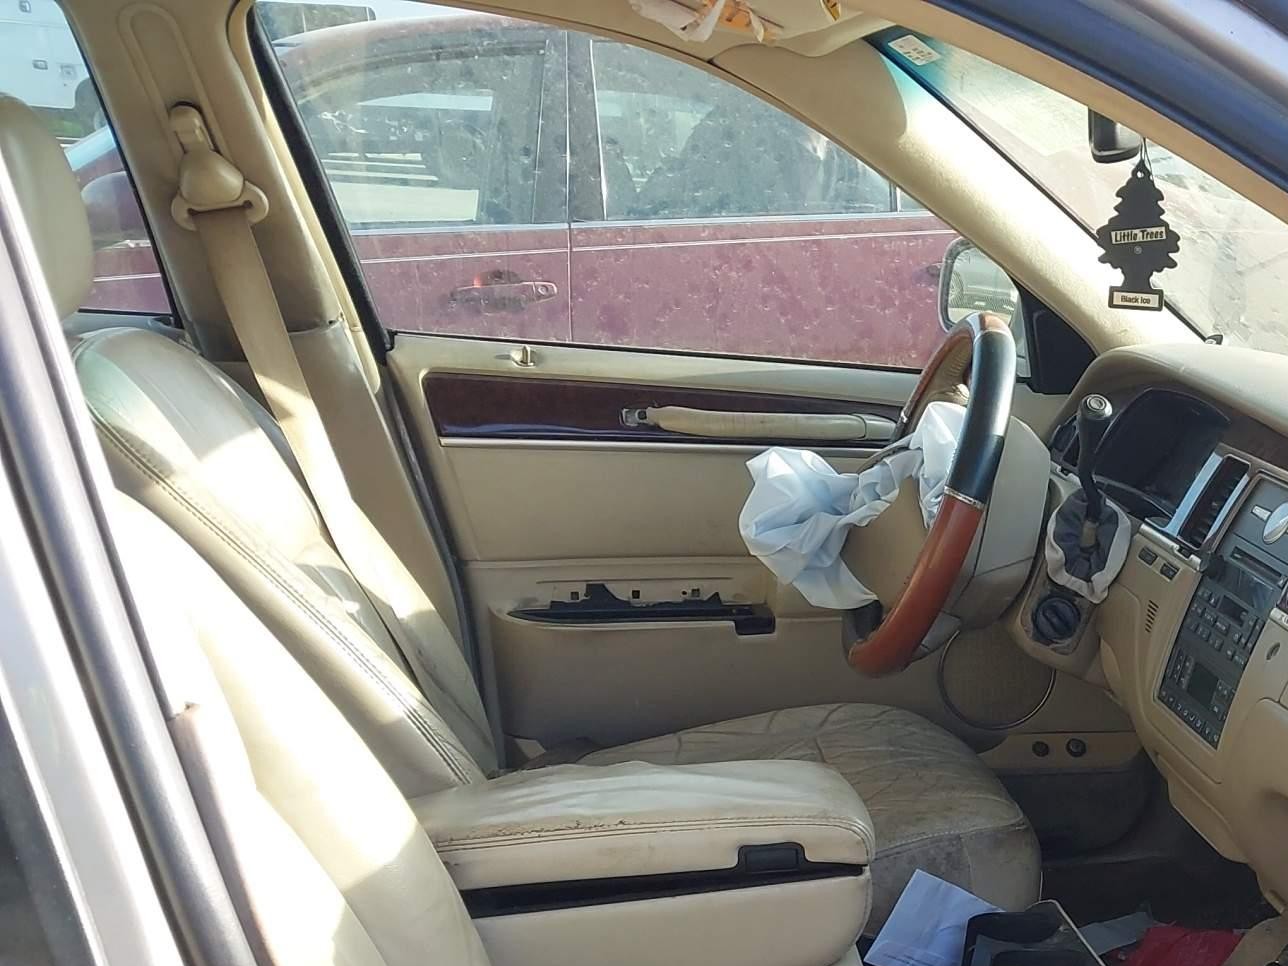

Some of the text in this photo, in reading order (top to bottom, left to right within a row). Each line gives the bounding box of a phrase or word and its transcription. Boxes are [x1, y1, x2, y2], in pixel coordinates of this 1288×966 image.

[1115, 229, 1163, 242] Little Trees
[1121, 295, 1139, 304] Black
